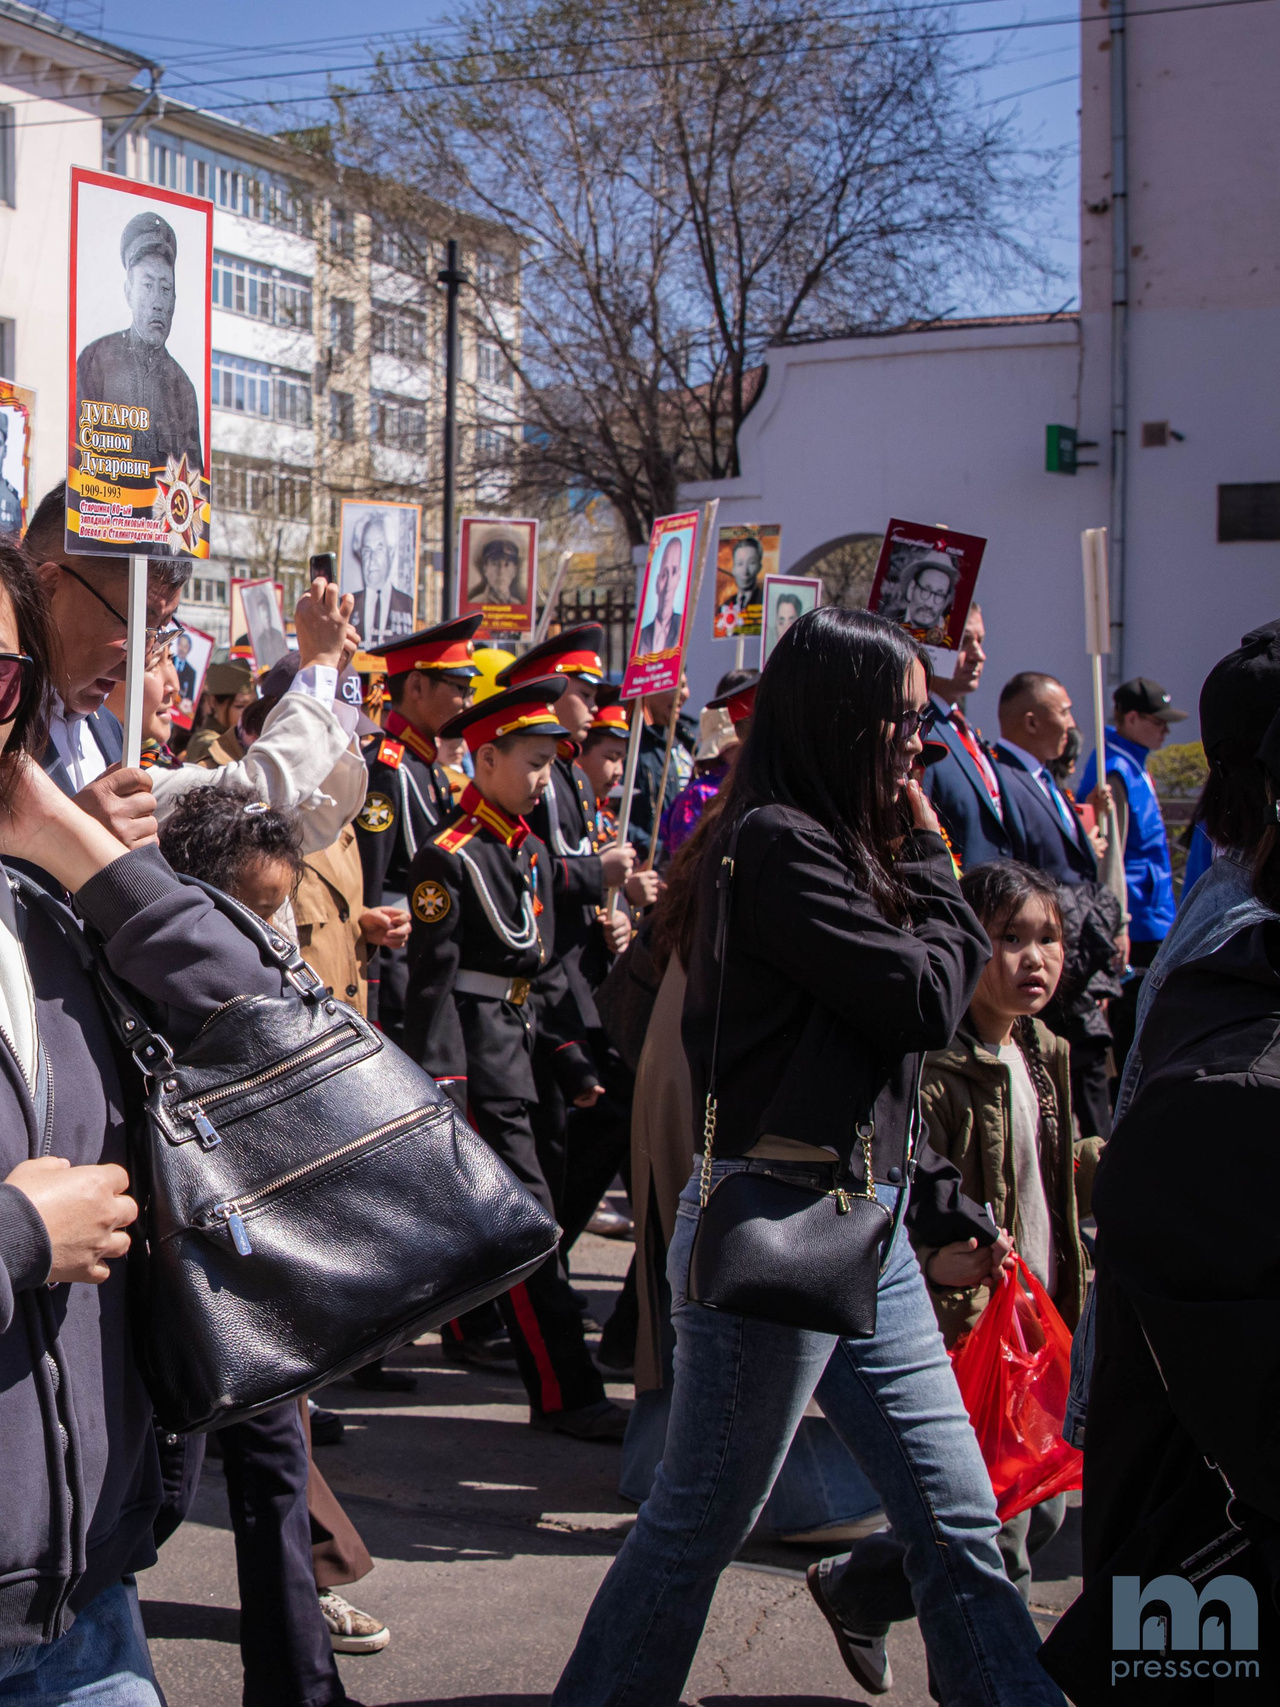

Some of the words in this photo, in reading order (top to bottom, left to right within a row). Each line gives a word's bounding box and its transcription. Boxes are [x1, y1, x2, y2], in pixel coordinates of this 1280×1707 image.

[81, 402, 149, 429] ДУГАРОВ
[81, 427, 131, 451] Содном
[80, 452, 150, 479] Дугарович
[80, 483, 122, 499] 1909-1993
